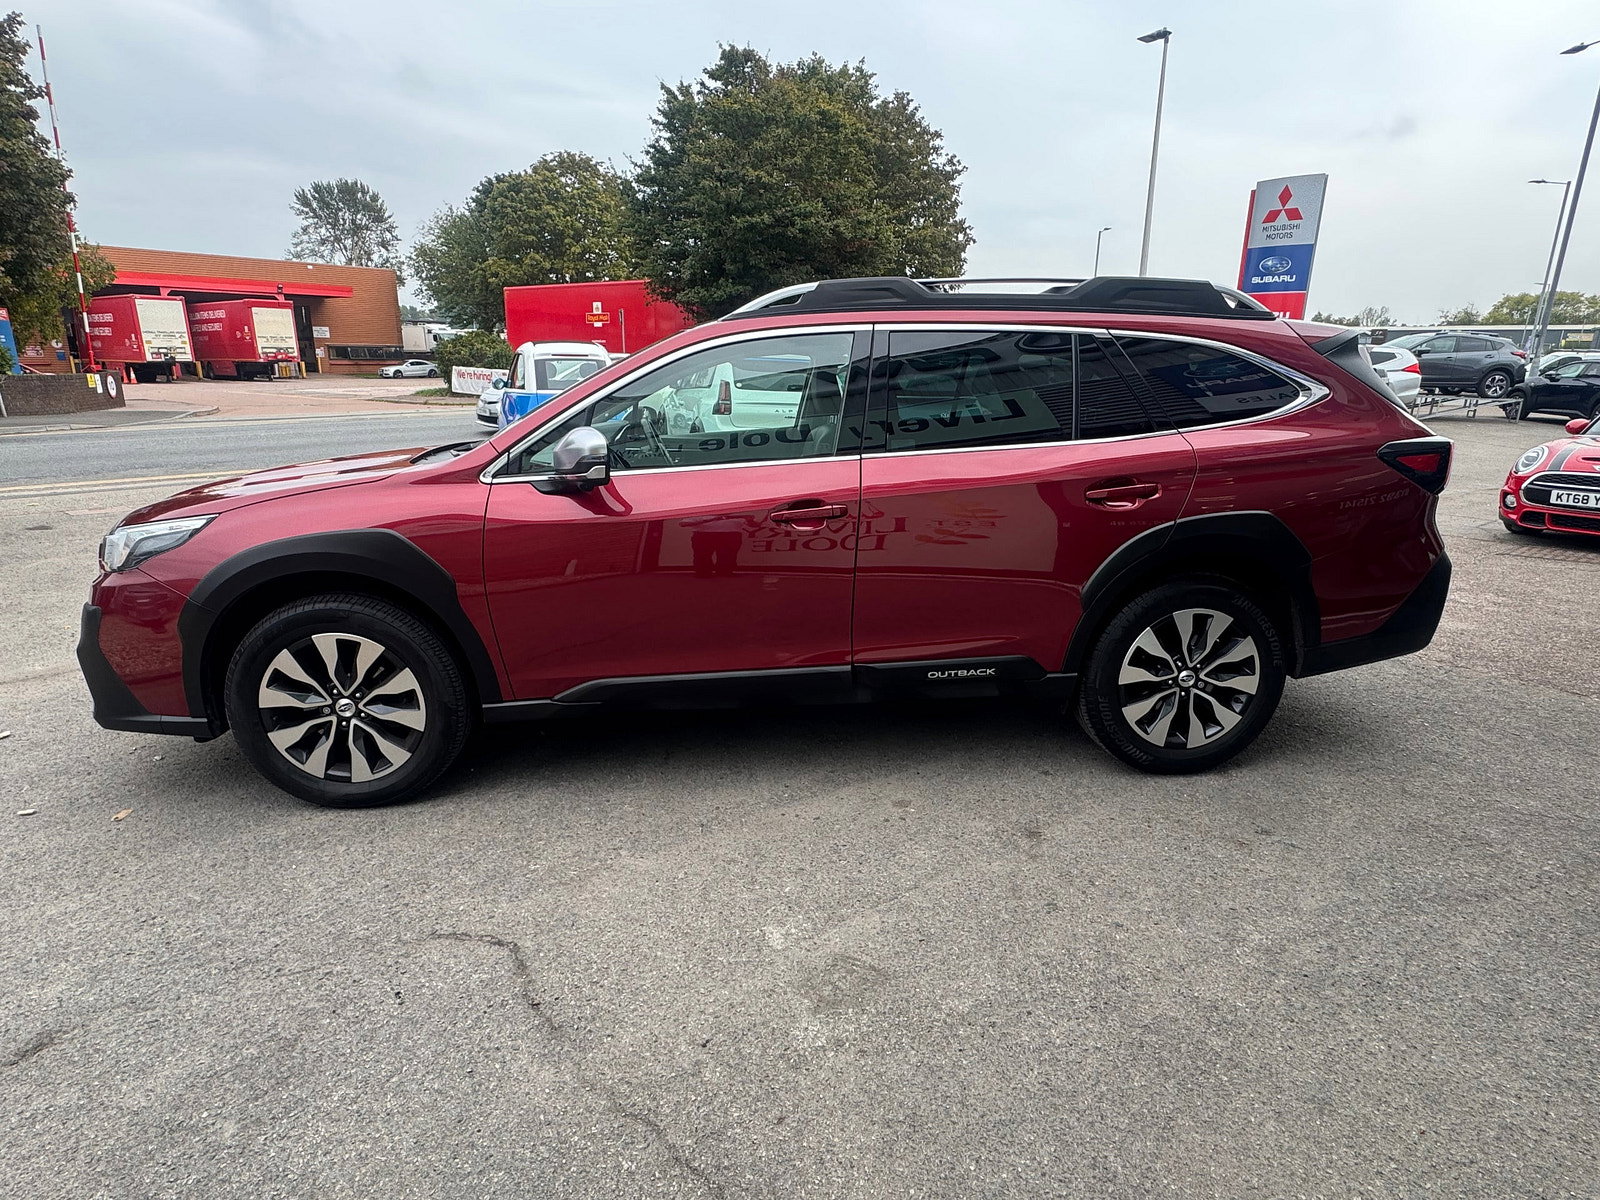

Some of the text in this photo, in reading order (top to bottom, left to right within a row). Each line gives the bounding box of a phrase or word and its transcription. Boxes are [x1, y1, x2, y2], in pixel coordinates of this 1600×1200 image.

[1262, 223, 1301, 233] MITSUBISHI
[1265, 232, 1293, 241] MOTORS
[1251, 274, 1296, 284] SUBARU
[456, 369, 493, 384] We're hiring!
[1556, 491, 1590, 505] KT68
[927, 667, 996, 679] OUTBACK
